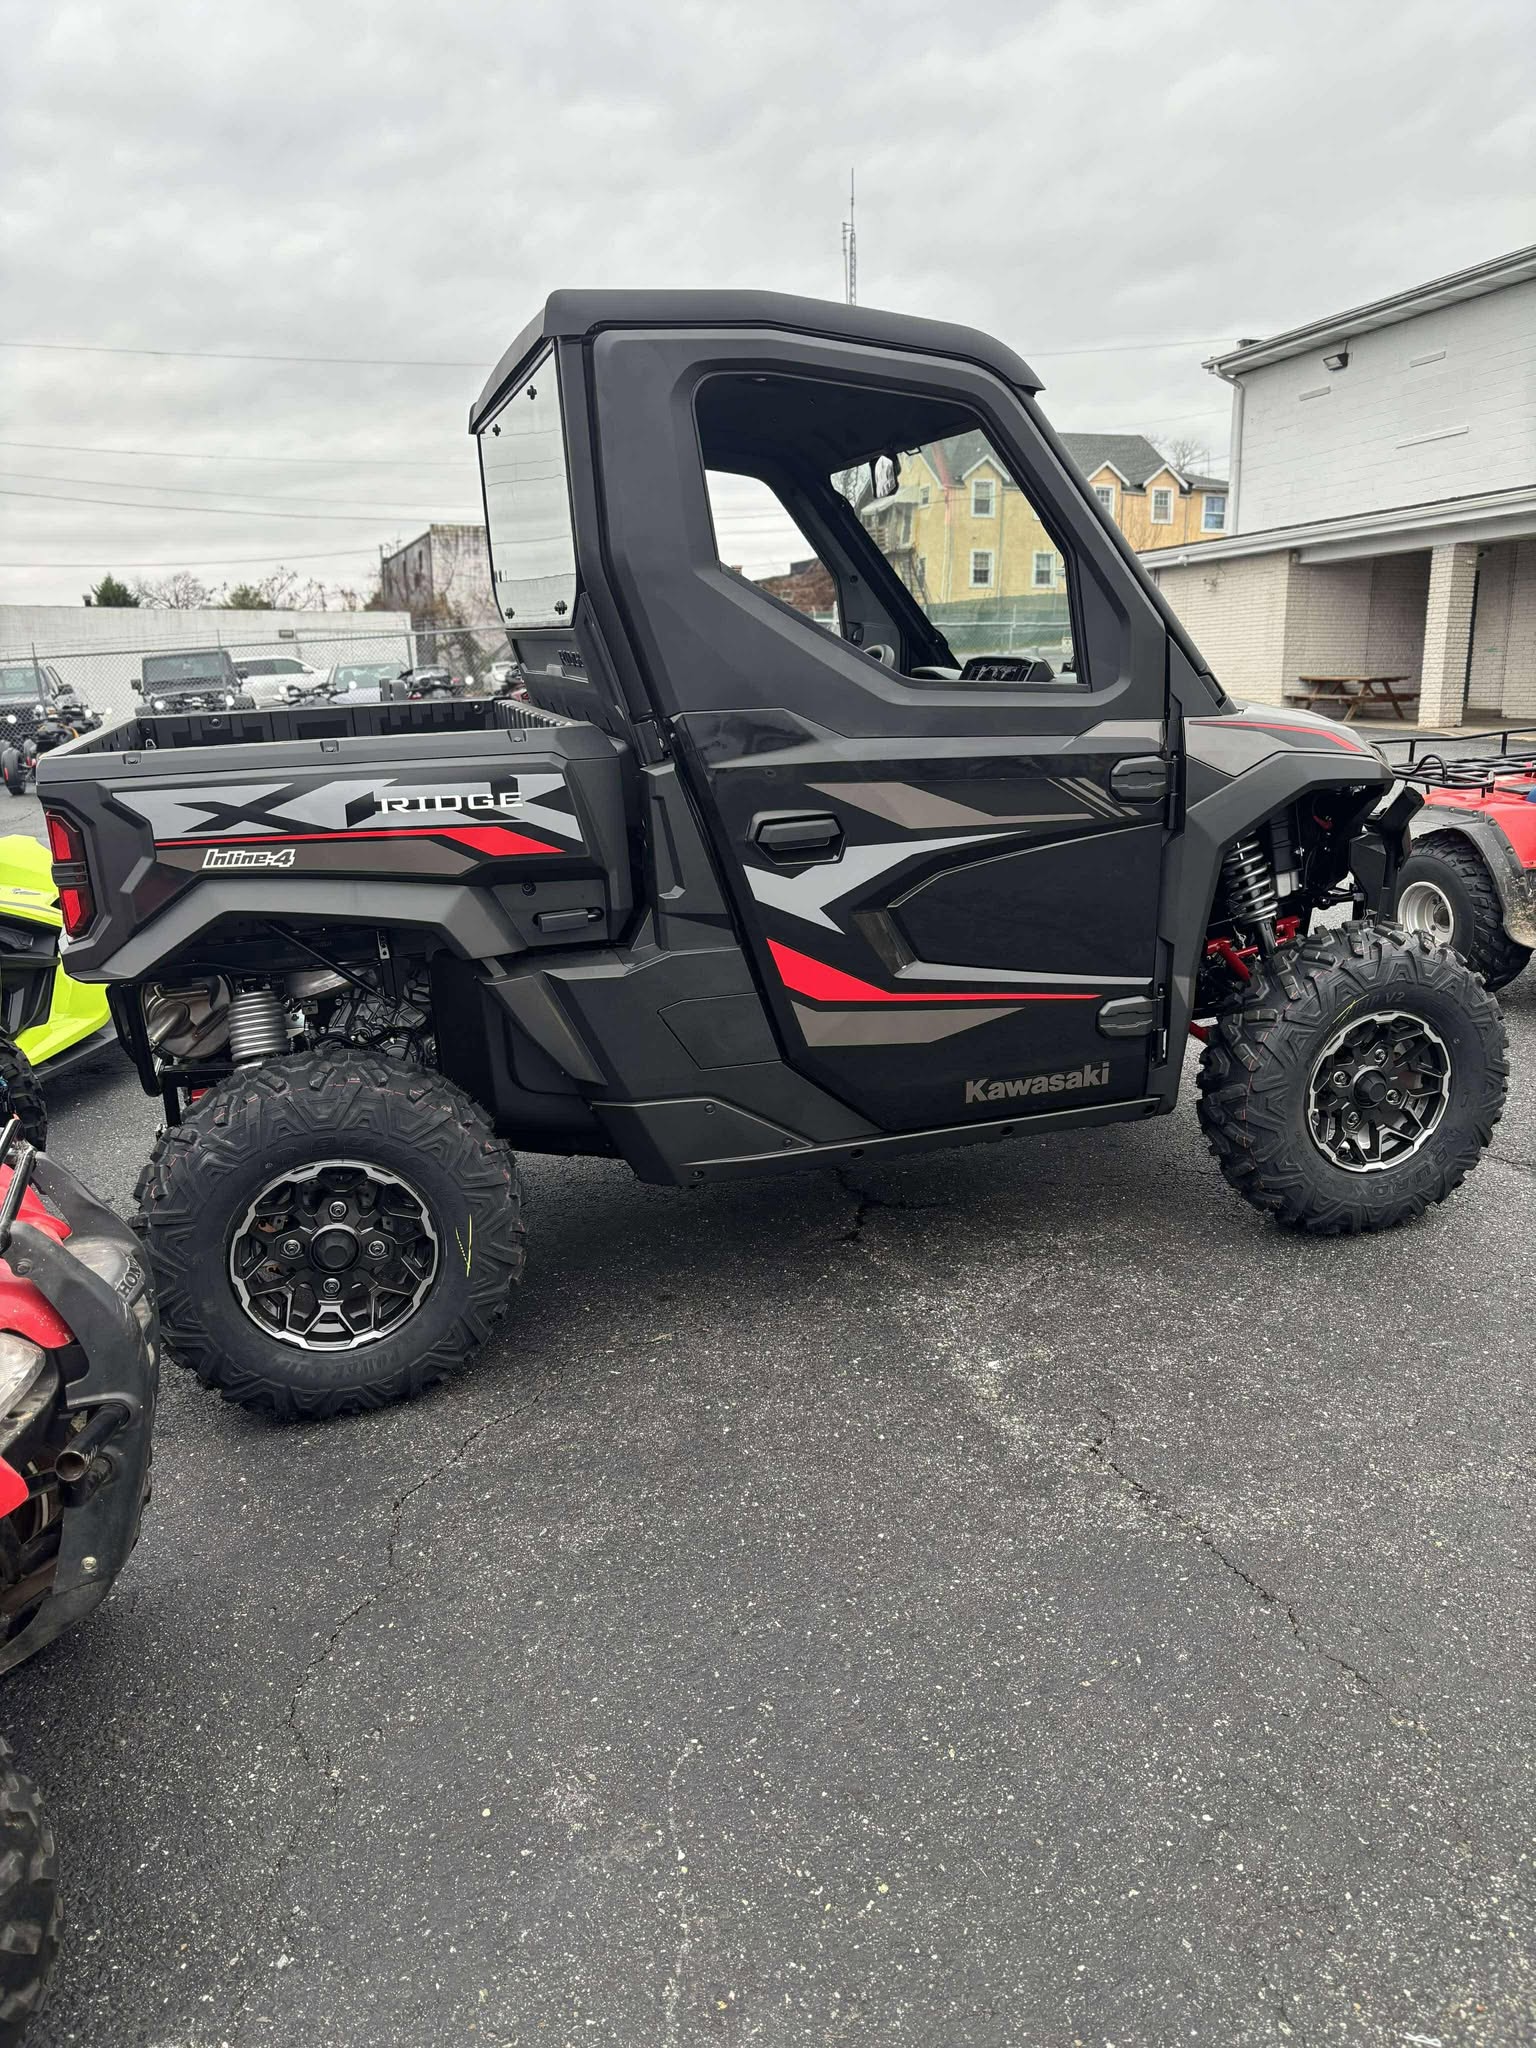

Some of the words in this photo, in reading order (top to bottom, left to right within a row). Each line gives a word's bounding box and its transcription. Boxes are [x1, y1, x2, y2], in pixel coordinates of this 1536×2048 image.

[380, 791, 524, 815] RIDGE
[202, 848, 297, 869] Inline-4
[965, 1061, 1110, 1104] Kawasaki
